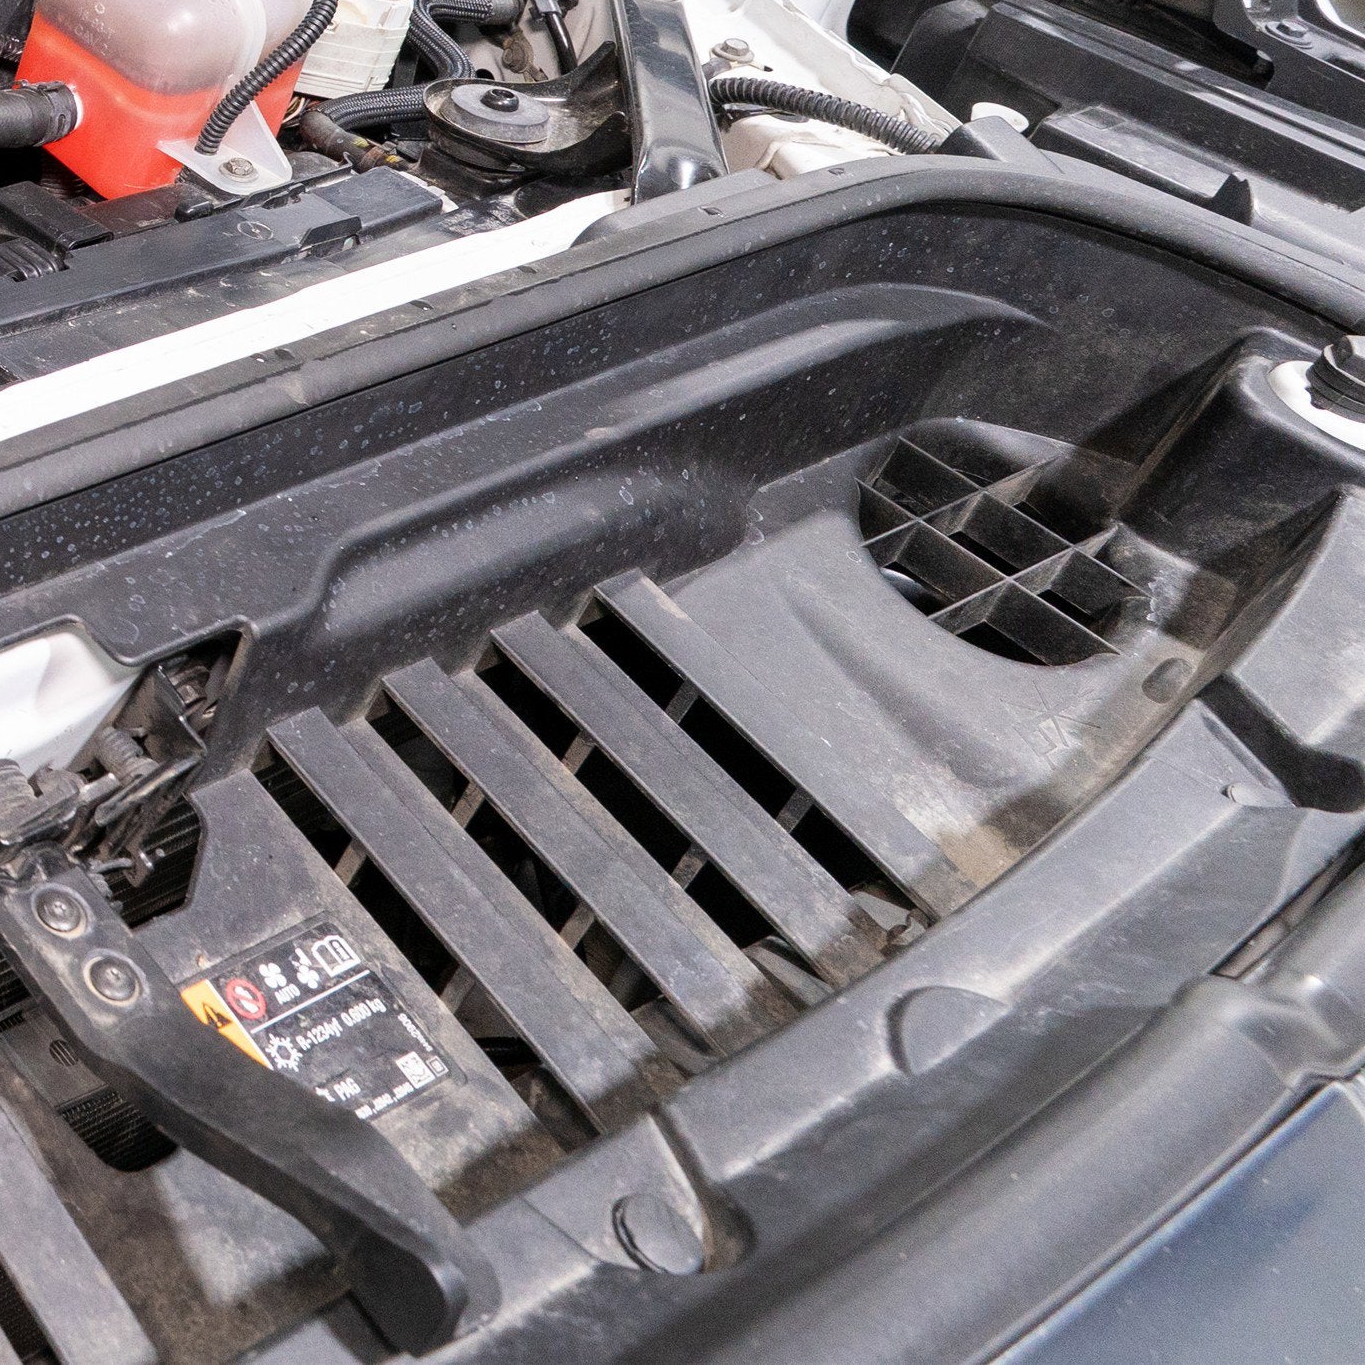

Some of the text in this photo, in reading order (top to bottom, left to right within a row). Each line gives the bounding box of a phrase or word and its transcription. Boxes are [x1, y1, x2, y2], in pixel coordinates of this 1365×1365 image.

[274, 983, 301, 1005] AUTO
[295, 997, 387, 1051] R-1234yf 0.600 kg
[333, 1077, 362, 1102] PAG
